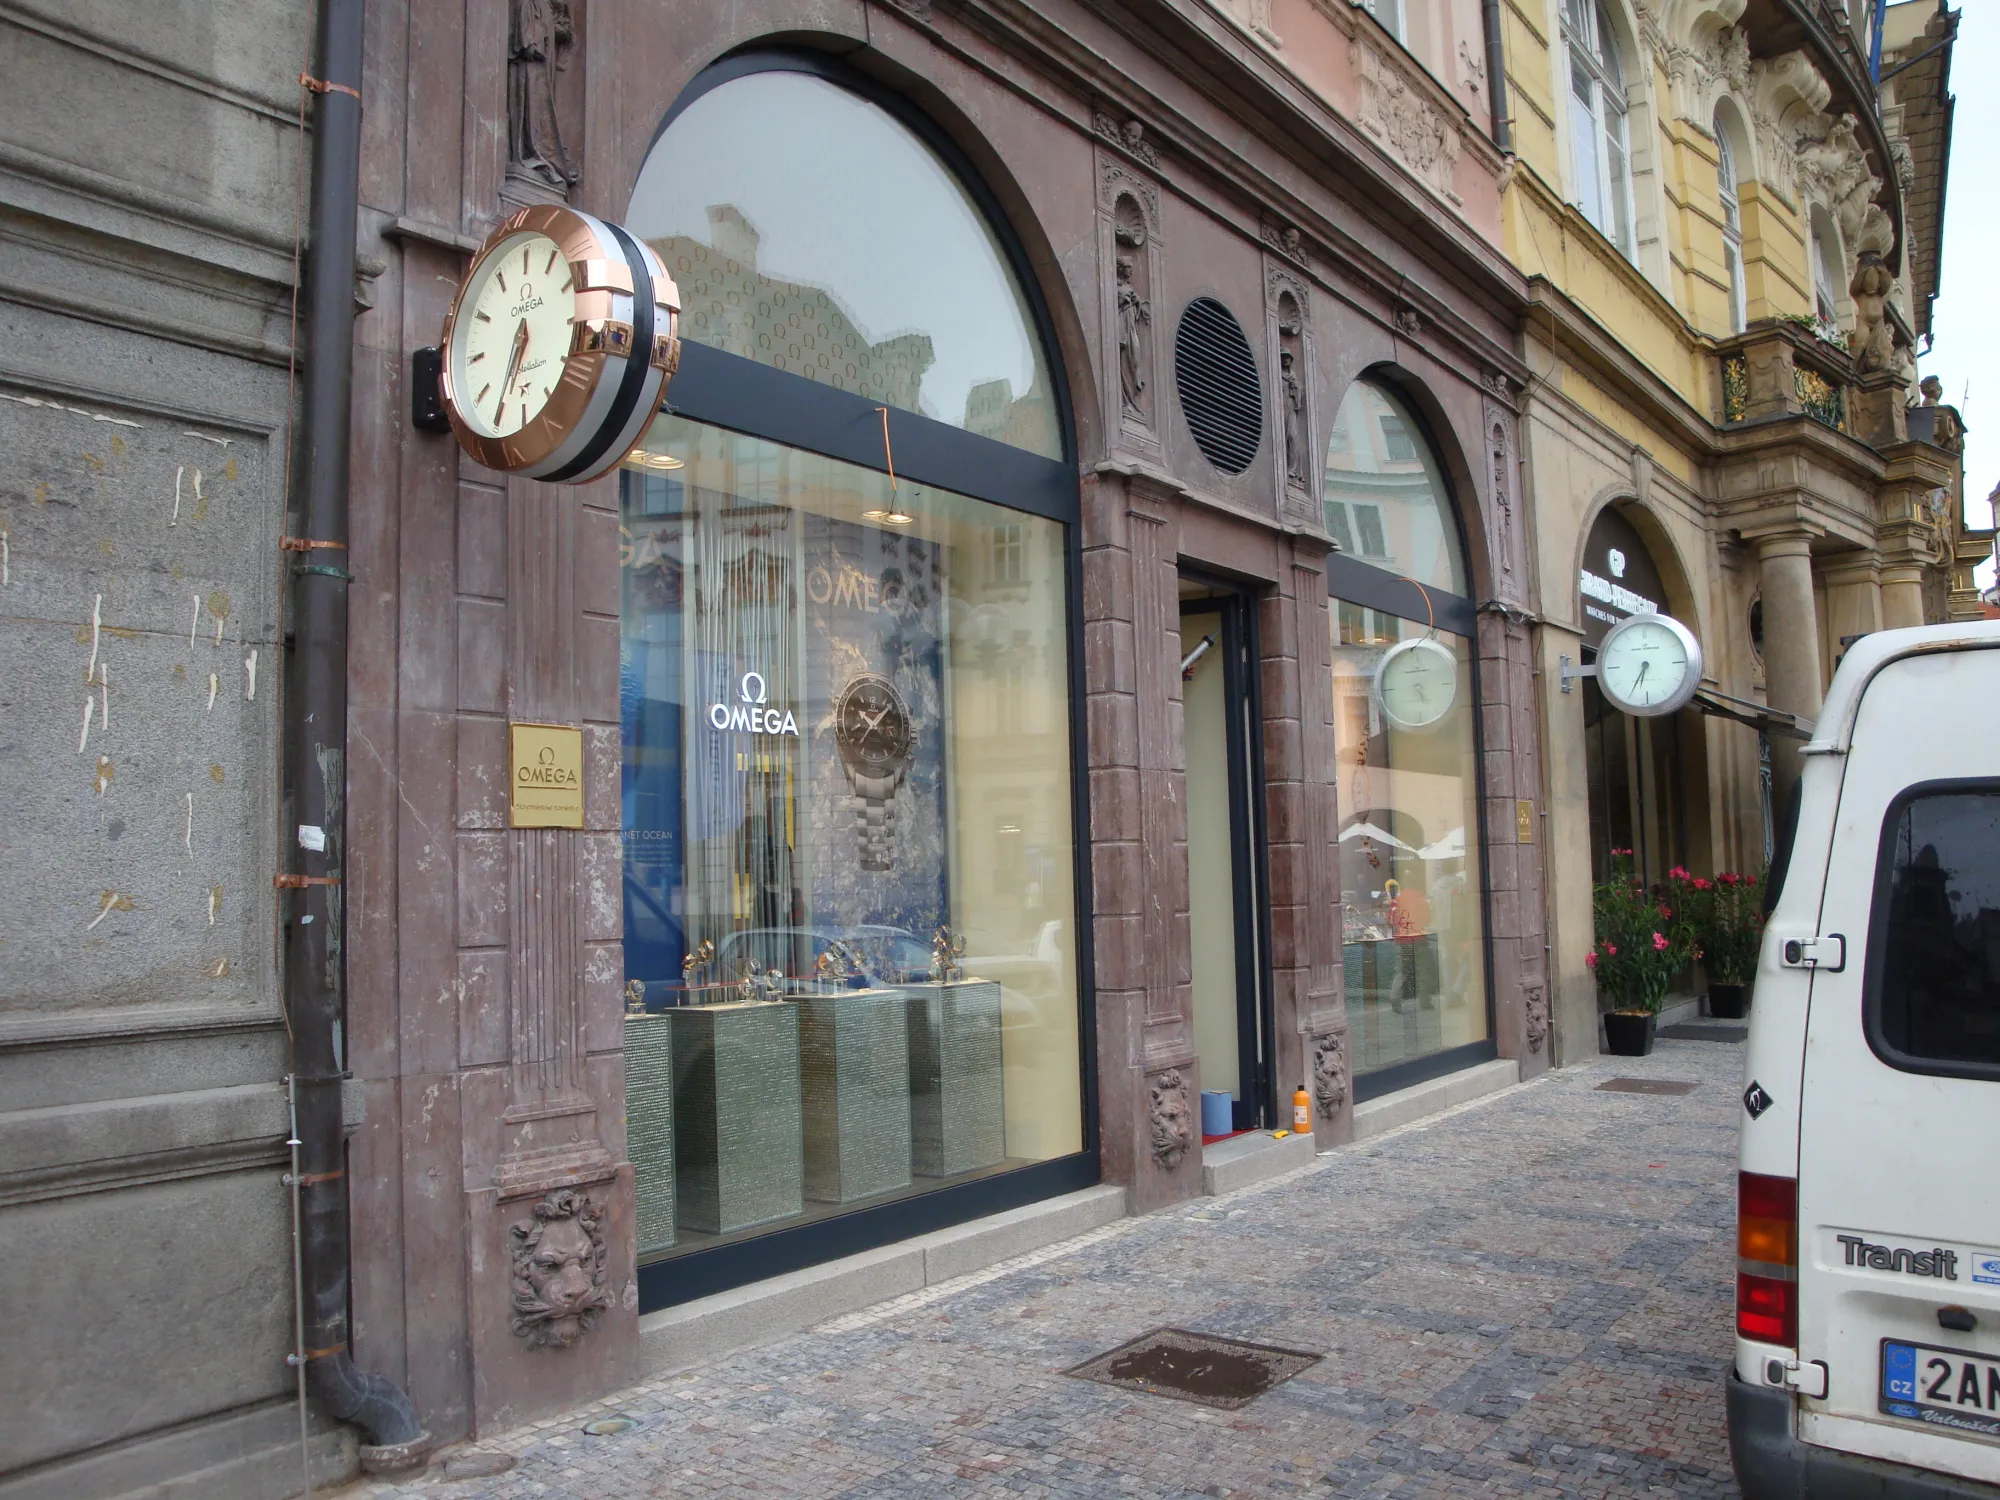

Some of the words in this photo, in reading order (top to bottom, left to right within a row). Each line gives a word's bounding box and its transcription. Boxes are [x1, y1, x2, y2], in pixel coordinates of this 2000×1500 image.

[510, 296, 544, 317] OMEGA
[710, 703, 799, 736] OMEGA
[518, 766, 577, 784] OMEGA
[642, 830, 673, 840] OCEAN
[1837, 1234, 1958, 1280] Transit
[1890, 1379, 1913, 1395] CZ
